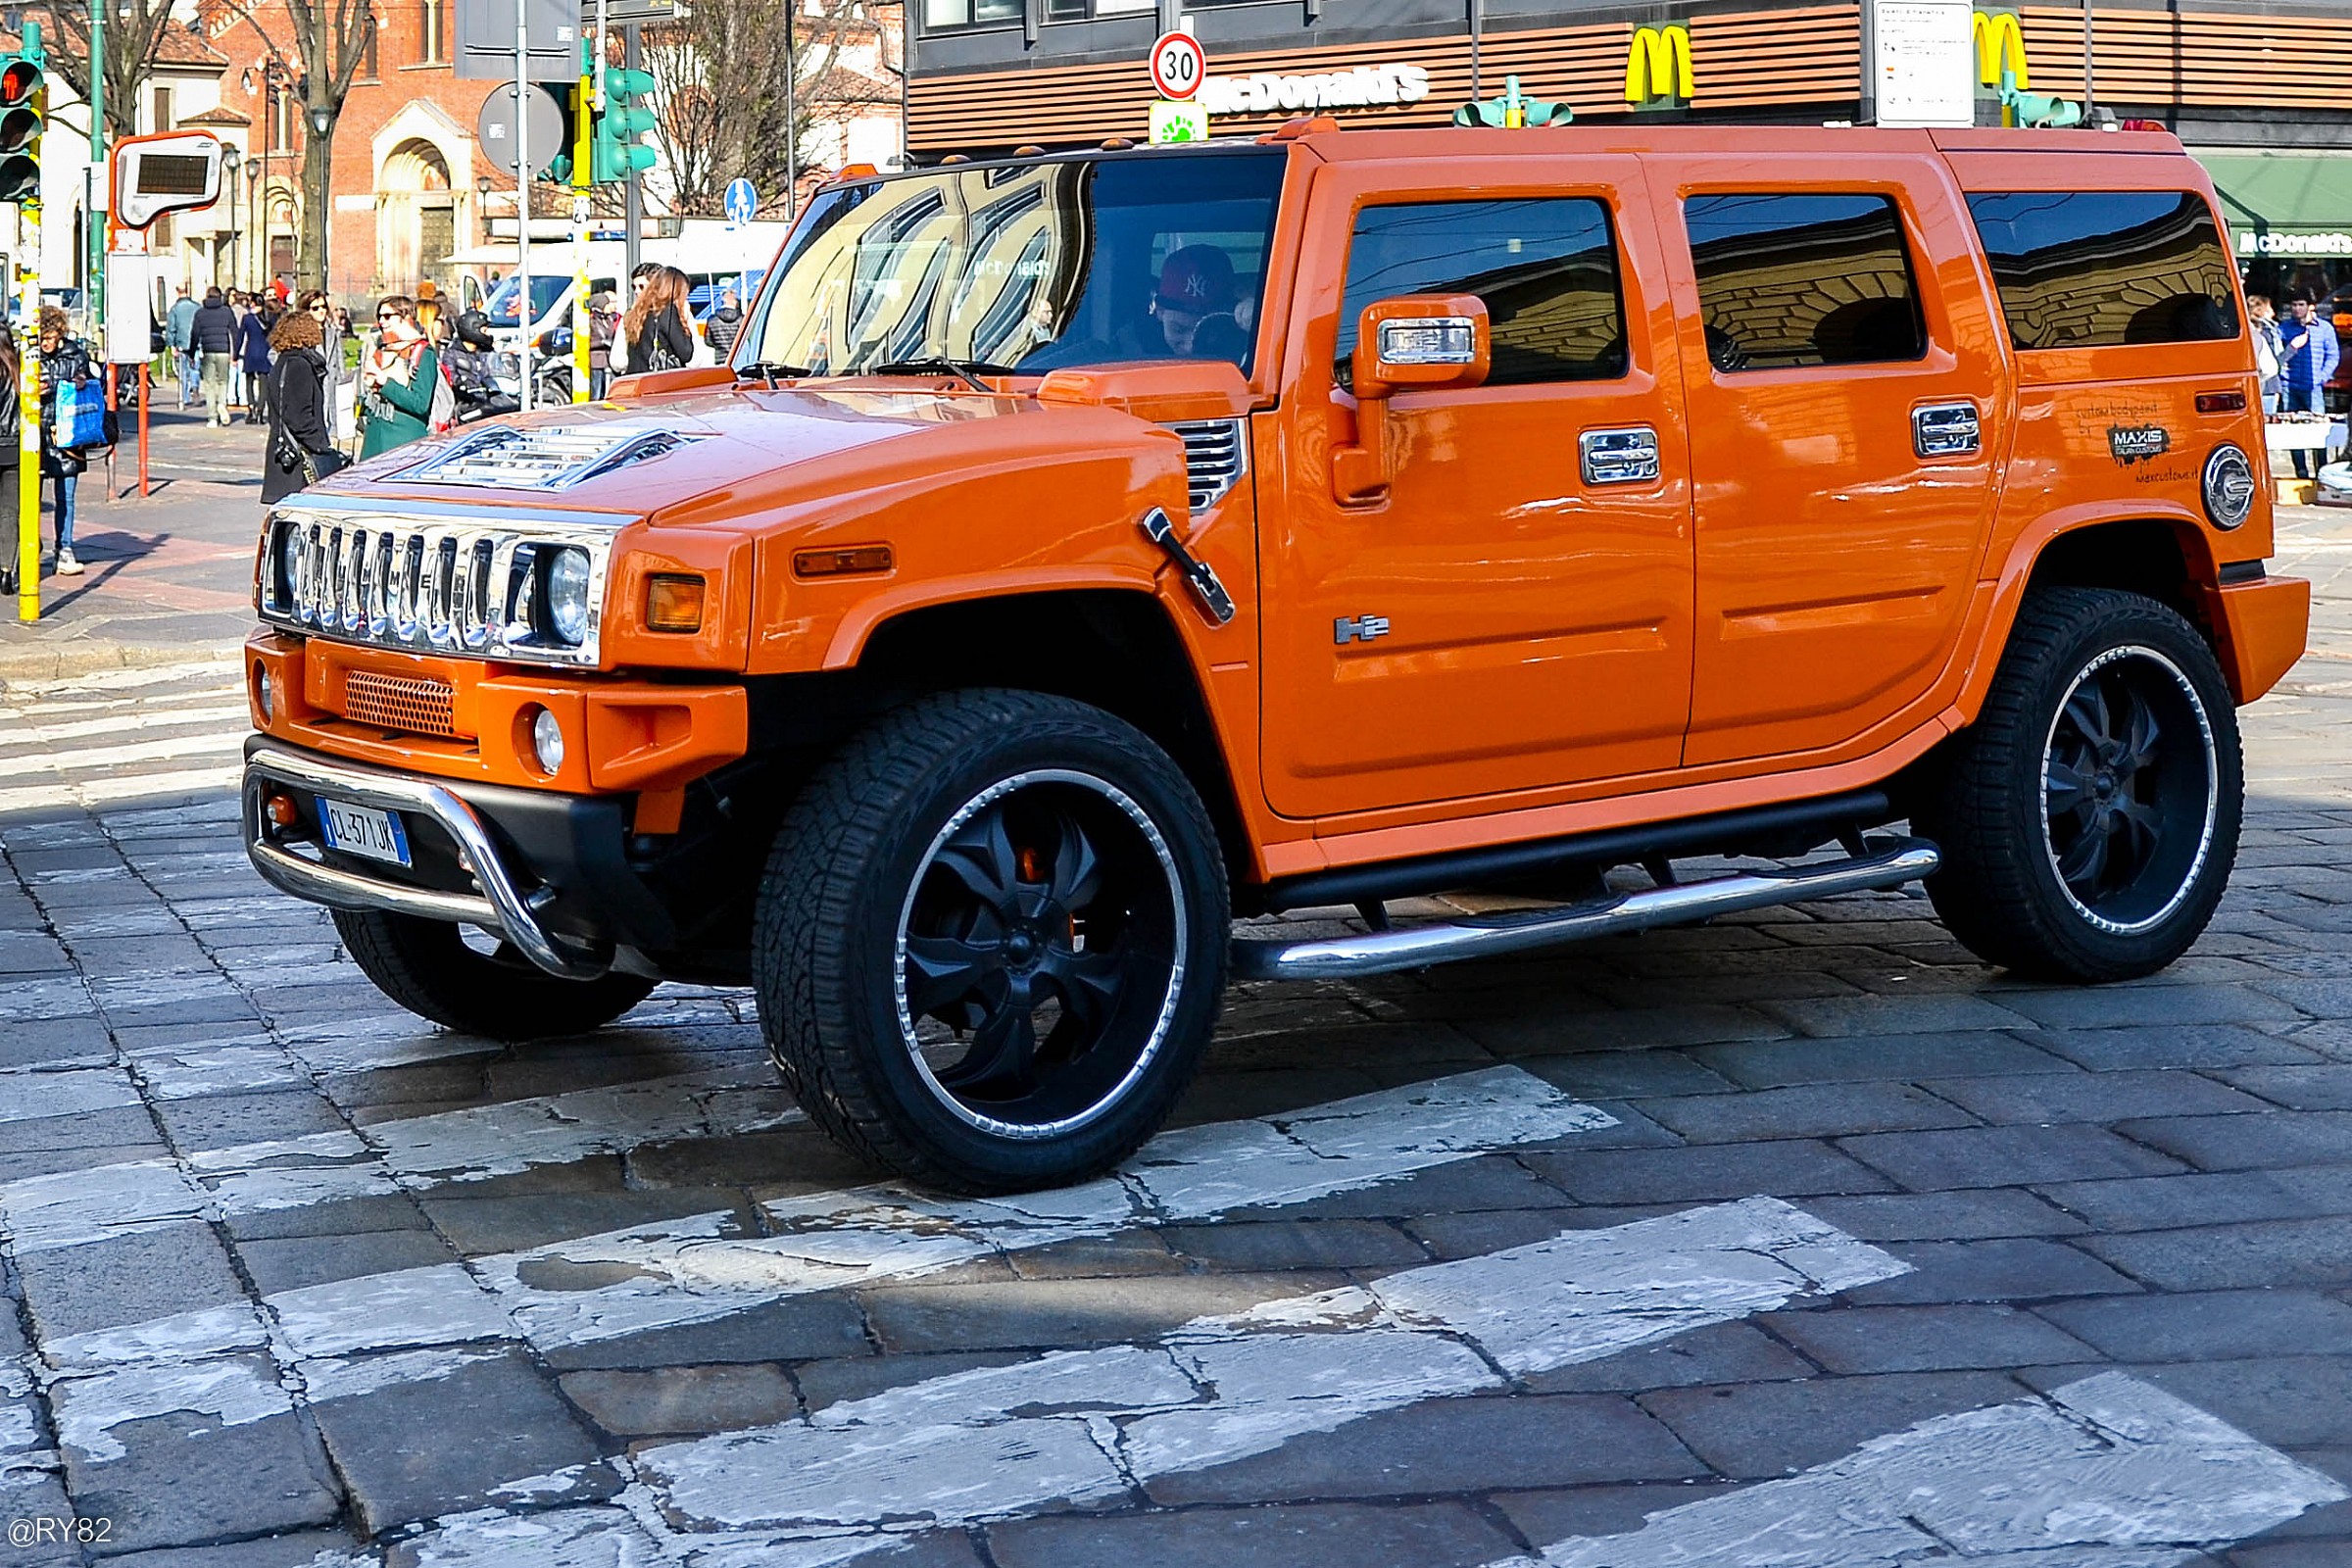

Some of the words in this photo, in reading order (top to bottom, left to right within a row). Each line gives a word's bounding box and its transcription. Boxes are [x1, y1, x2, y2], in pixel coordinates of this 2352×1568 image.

[1164, 50, 1194, 81] 30
[2239, 232, 2352, 254] McDonald's
[2114, 429, 2162, 446] MAXIS
[1334, 614, 1389, 644] H2
